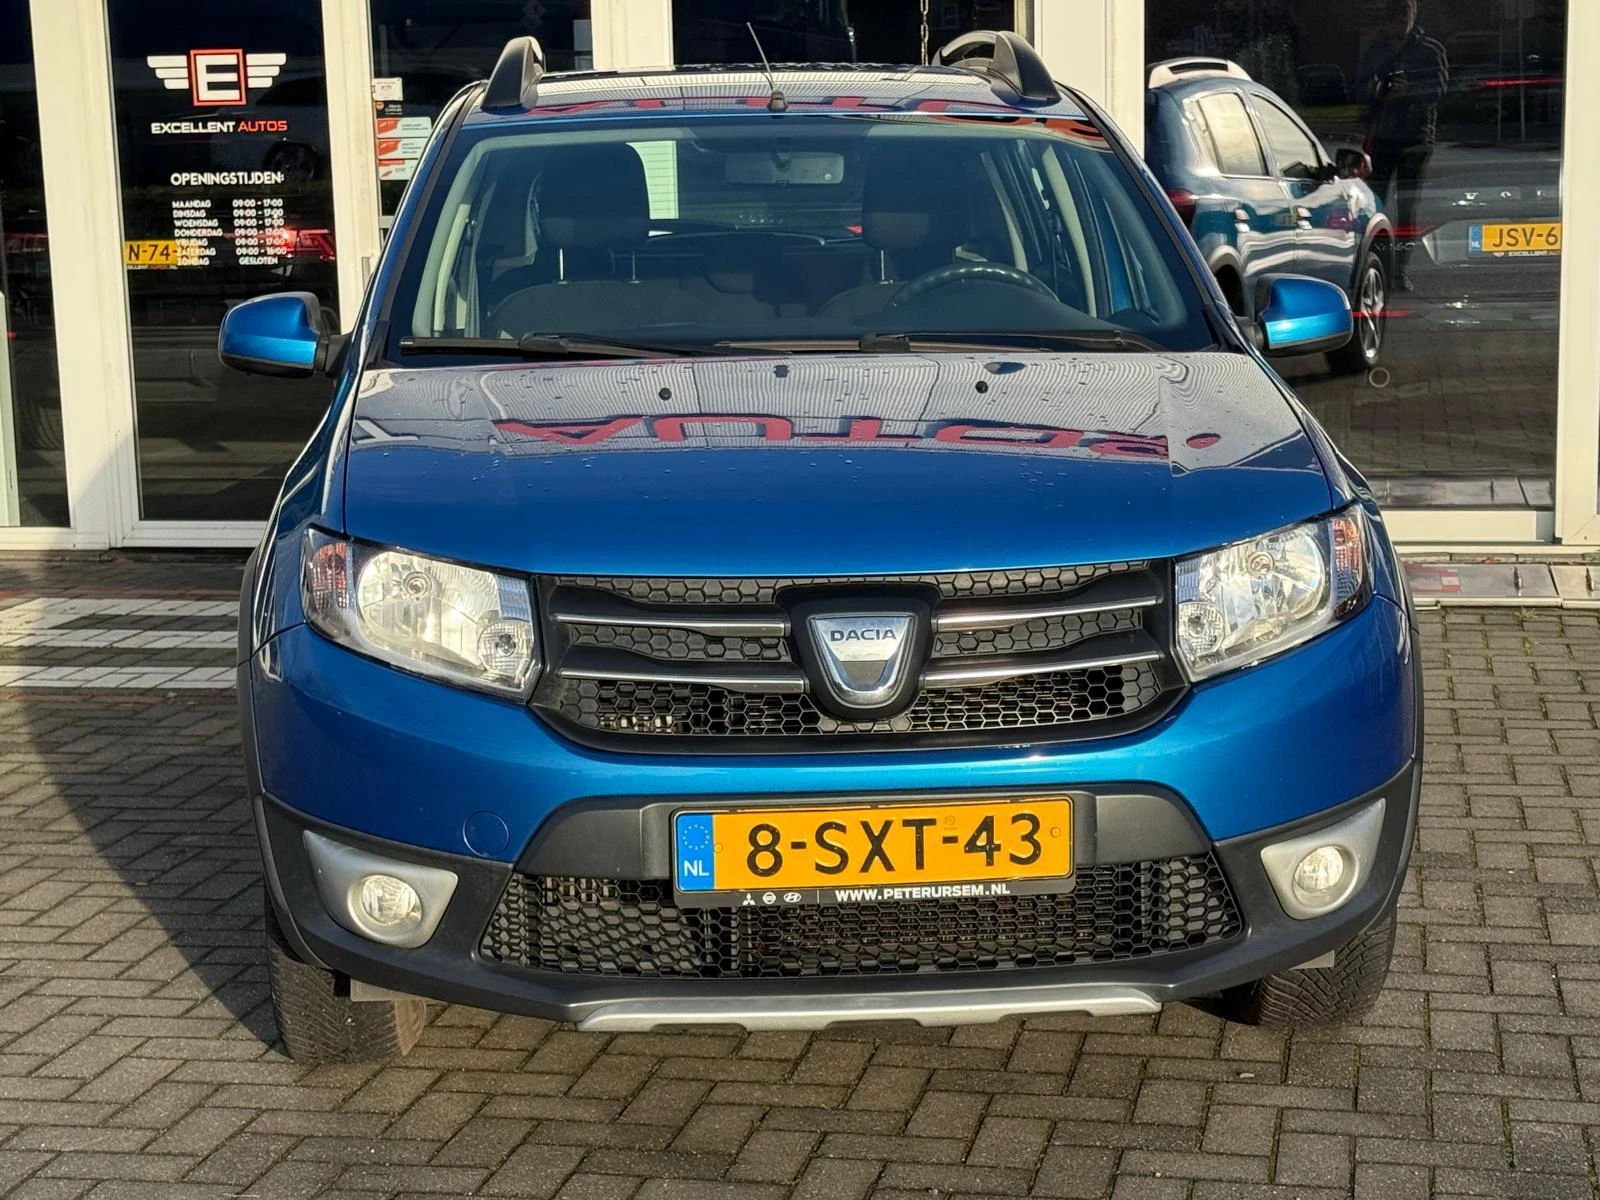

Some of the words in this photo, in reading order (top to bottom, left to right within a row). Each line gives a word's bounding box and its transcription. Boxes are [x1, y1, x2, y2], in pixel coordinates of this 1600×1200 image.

[195, 54, 241, 101] E
[150, 121, 236, 134] EXCELLENT
[237, 120, 288, 132] AUTOS
[170, 171, 285, 186] OPENINGSTIJDEN:
[172, 199, 211, 208] MAANDAG
[232, 199, 256, 207] 09:00
[263, 198, 283, 207] 17:00
[173, 209, 206, 218] DINSDAG
[233, 209, 256, 217] 09:00
[173, 218, 219, 227] WOENSDAG
[234, 218, 257, 227] 09:00
[174, 228, 223, 237] DONDERDAG
[235, 228, 258, 236] 09:00
[1492, 227, 1559, 247] JSV-6
[235, 238, 258, 246] 09:00
[236, 247, 259, 255] 09:00
[238, 257, 278, 266] GESLOTEN
[830, 628, 897, 642] DACIA
[683, 860, 710, 877] NL
[746, 813, 1042, 877] 8-SXT-43
[834, 883, 1011, 902] WWW.PETERURSEM.NL
